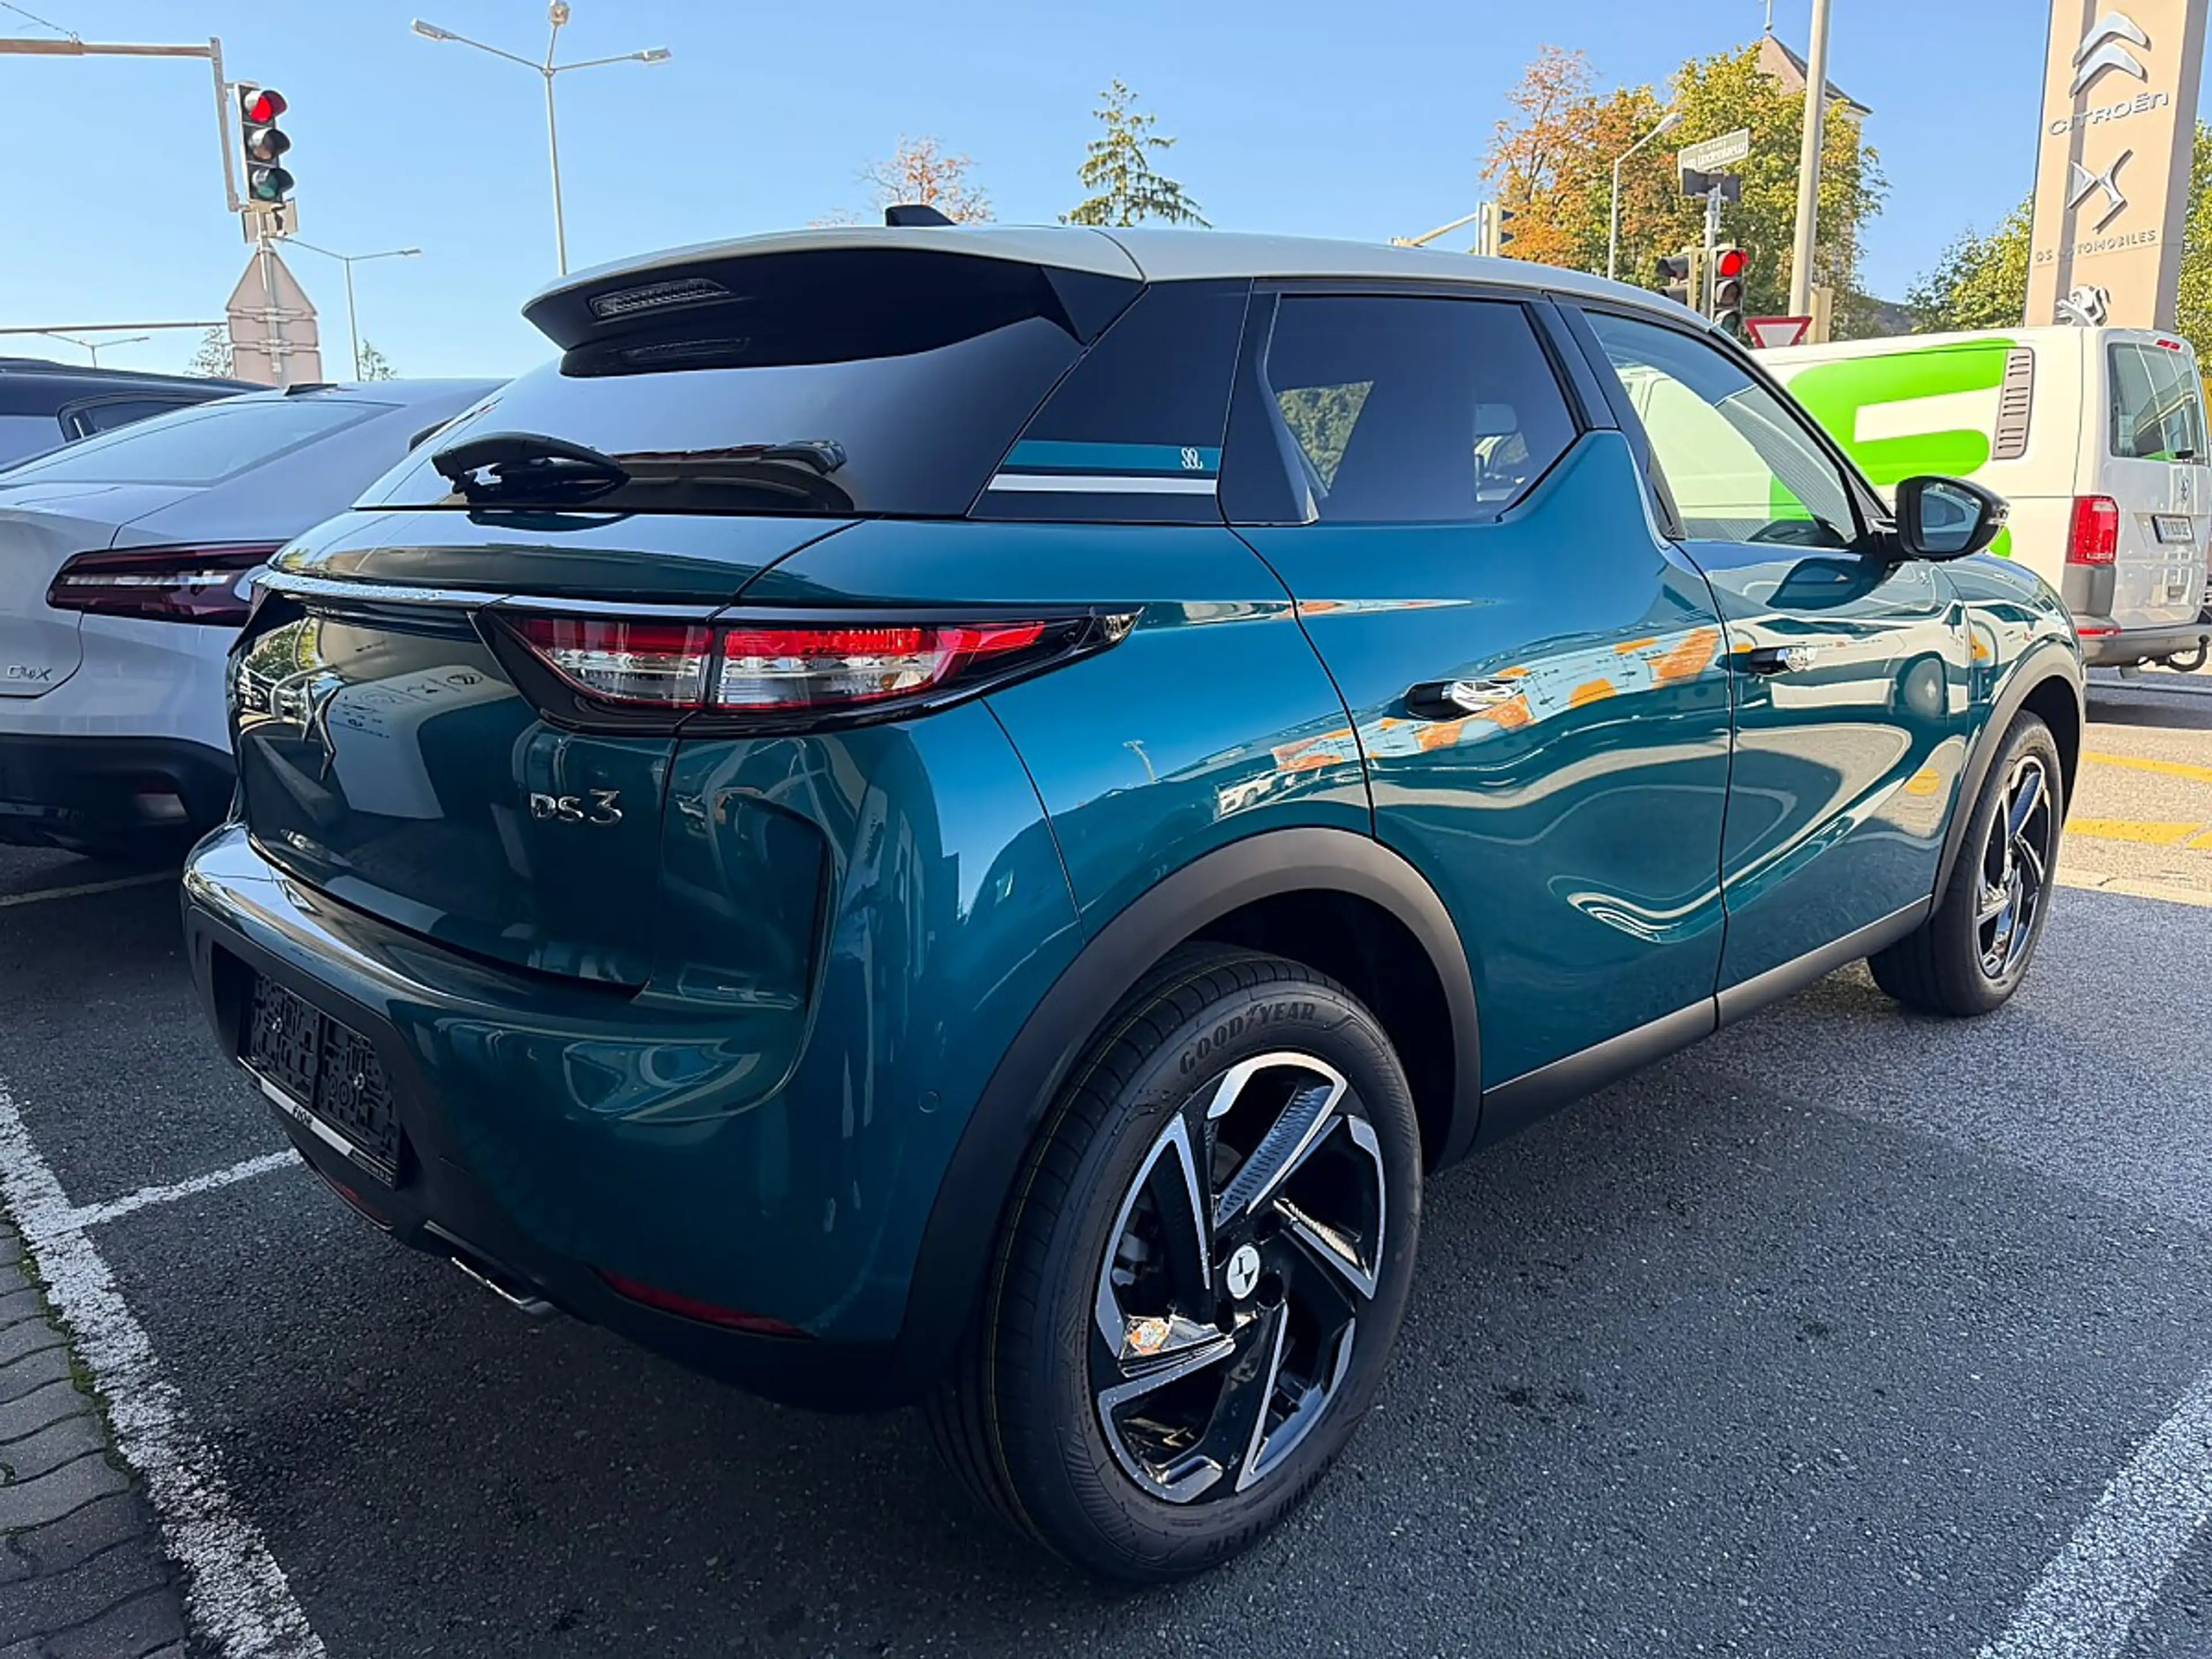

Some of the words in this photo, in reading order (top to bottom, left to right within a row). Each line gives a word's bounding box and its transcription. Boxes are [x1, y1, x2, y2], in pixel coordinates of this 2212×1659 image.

[531, 793, 584, 823] DS
[589, 789, 623, 825] 3
[1179, 1002, 1316, 1075] GOODYEAR
